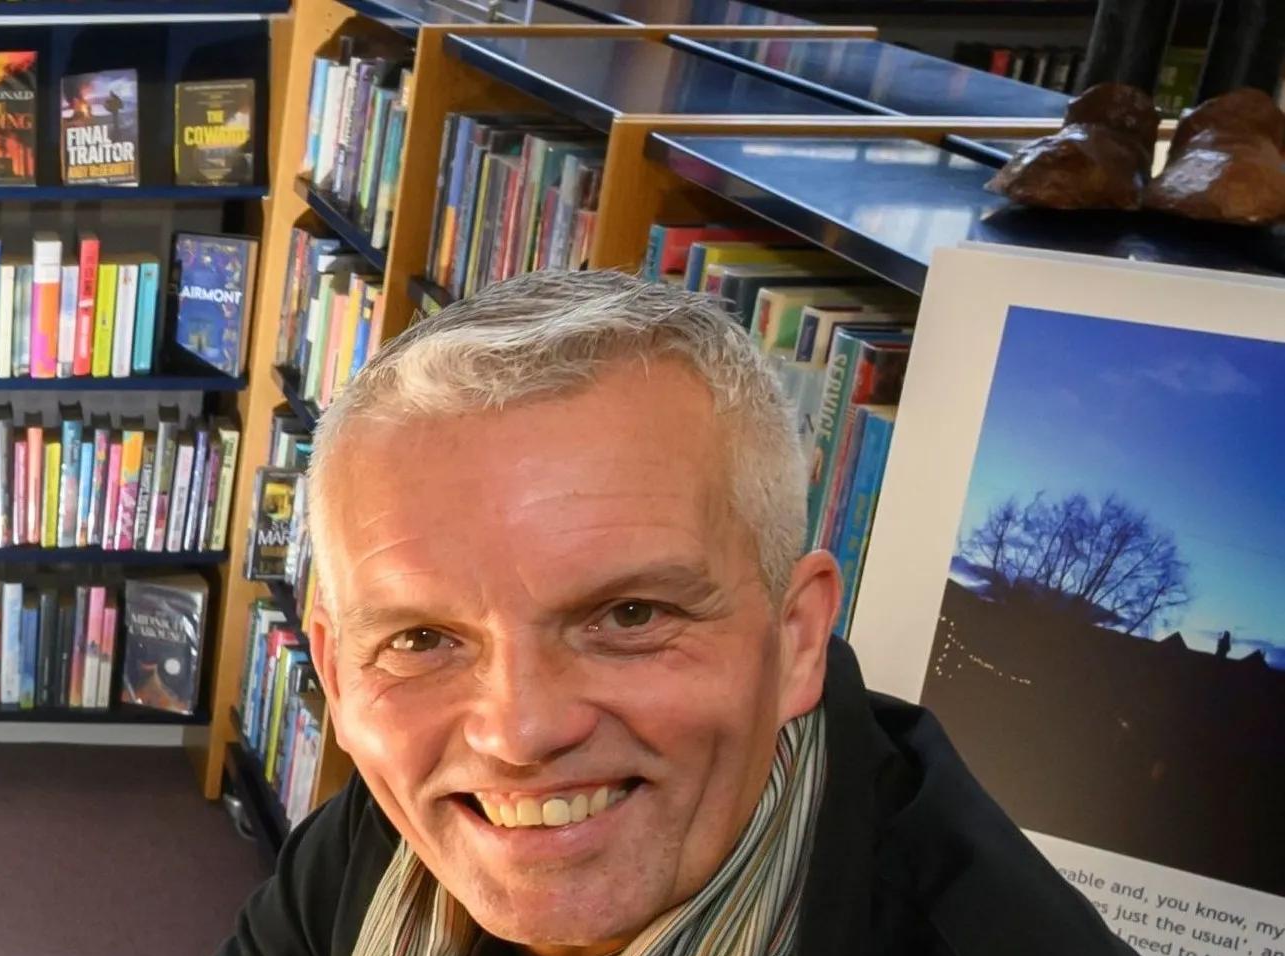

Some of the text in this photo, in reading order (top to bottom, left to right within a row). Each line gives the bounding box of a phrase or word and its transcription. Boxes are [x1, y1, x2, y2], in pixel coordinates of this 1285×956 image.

[66, 126, 110, 146] FINAL
[67, 142, 135, 165] TRAITOR
[1111, 881, 1148, 903] and,
[1157, 893, 1190, 913] you
[1195, 902, 1247, 930] know,
[1256, 921, 1285, 940] my
[1113, 904, 1149, 925] just
[1156, 915, 1186, 935] the
[1127, 934, 1173, 955] need
